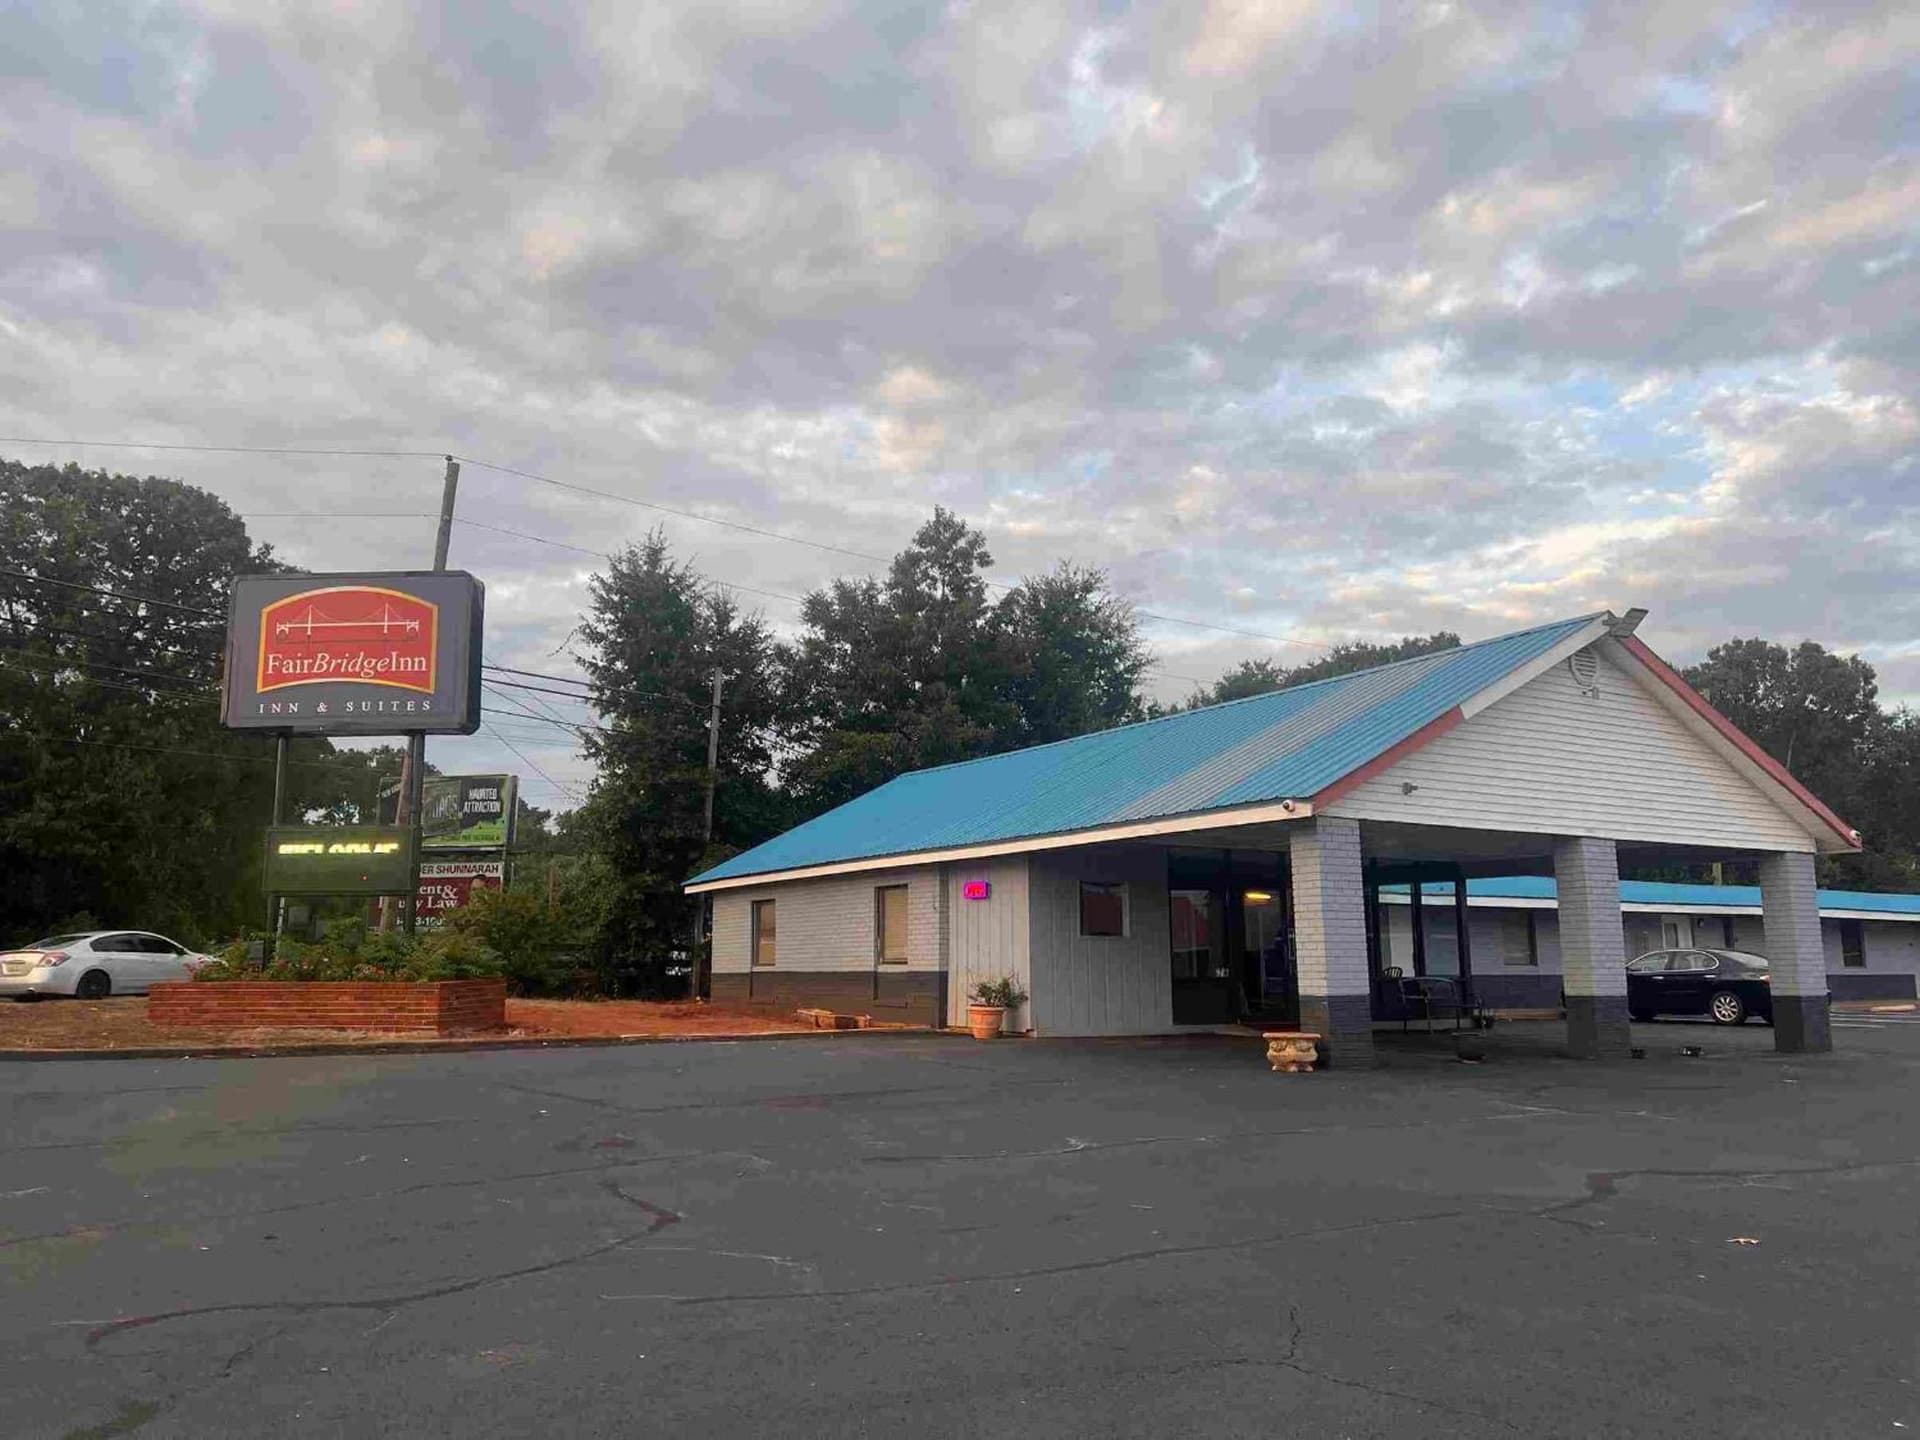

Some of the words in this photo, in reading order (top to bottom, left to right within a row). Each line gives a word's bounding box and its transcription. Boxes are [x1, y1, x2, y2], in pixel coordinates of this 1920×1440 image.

[267, 651, 427, 678] FairBridgeInn
[259, 702, 299, 714] INN
[317, 702, 328, 713] &
[346, 700, 431, 712] SUITES
[462, 801, 501, 813] ATTRACTION
[436, 863, 499, 875] SHUNNARAH
[442, 884, 459, 899] &
[427, 895, 458, 908] Law
